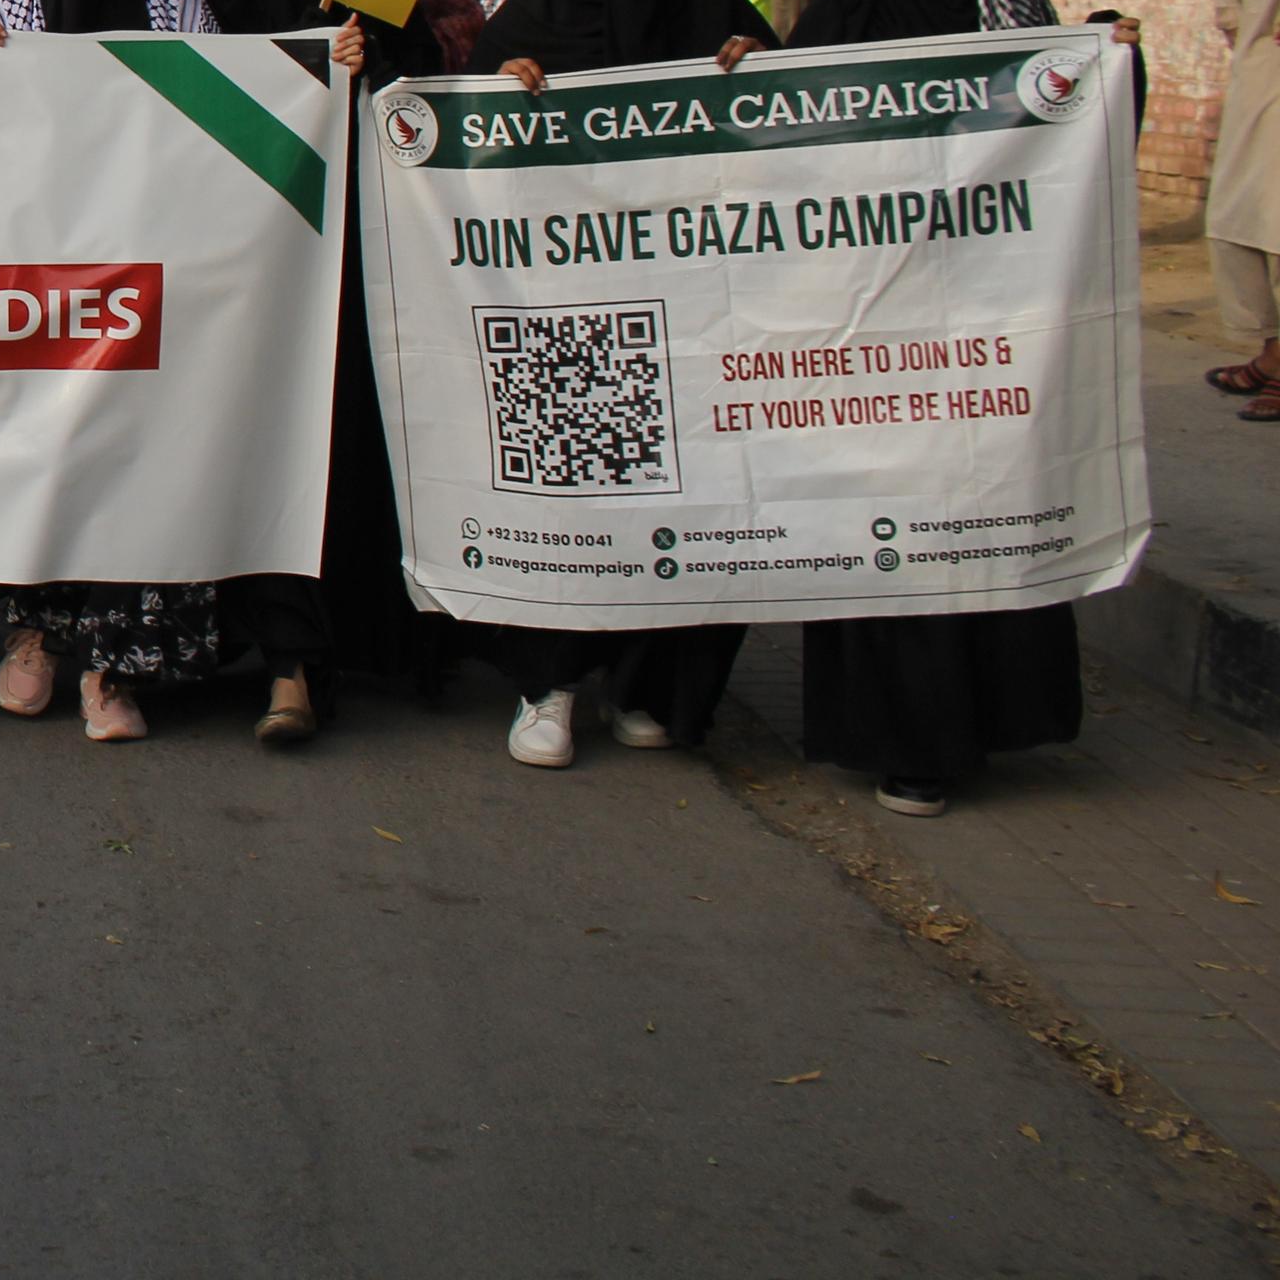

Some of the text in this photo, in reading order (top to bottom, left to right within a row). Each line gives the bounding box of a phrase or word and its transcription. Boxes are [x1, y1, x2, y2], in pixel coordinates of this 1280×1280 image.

[462, 76, 990, 148] SAVE GAZA CAMPAIGN
[450, 179, 1033, 268] JOIN SAVE GAZA CAMPAIGN
[722, 336, 1012, 382] SCAN HERE TO JOIN US &
[713, 386, 1031, 432] LET YOUR VOICE BE HEARD
[683, 524, 789, 545] savegazapk
[909, 503, 1076, 535] savegazacampaign
[487, 527, 613, 547] +92 332 590 0041
[907, 533, 1075, 566] savegazacampaign
[487, 554, 645, 578] savegazacampaign
[685, 552, 864, 577] savegaza.campaign
